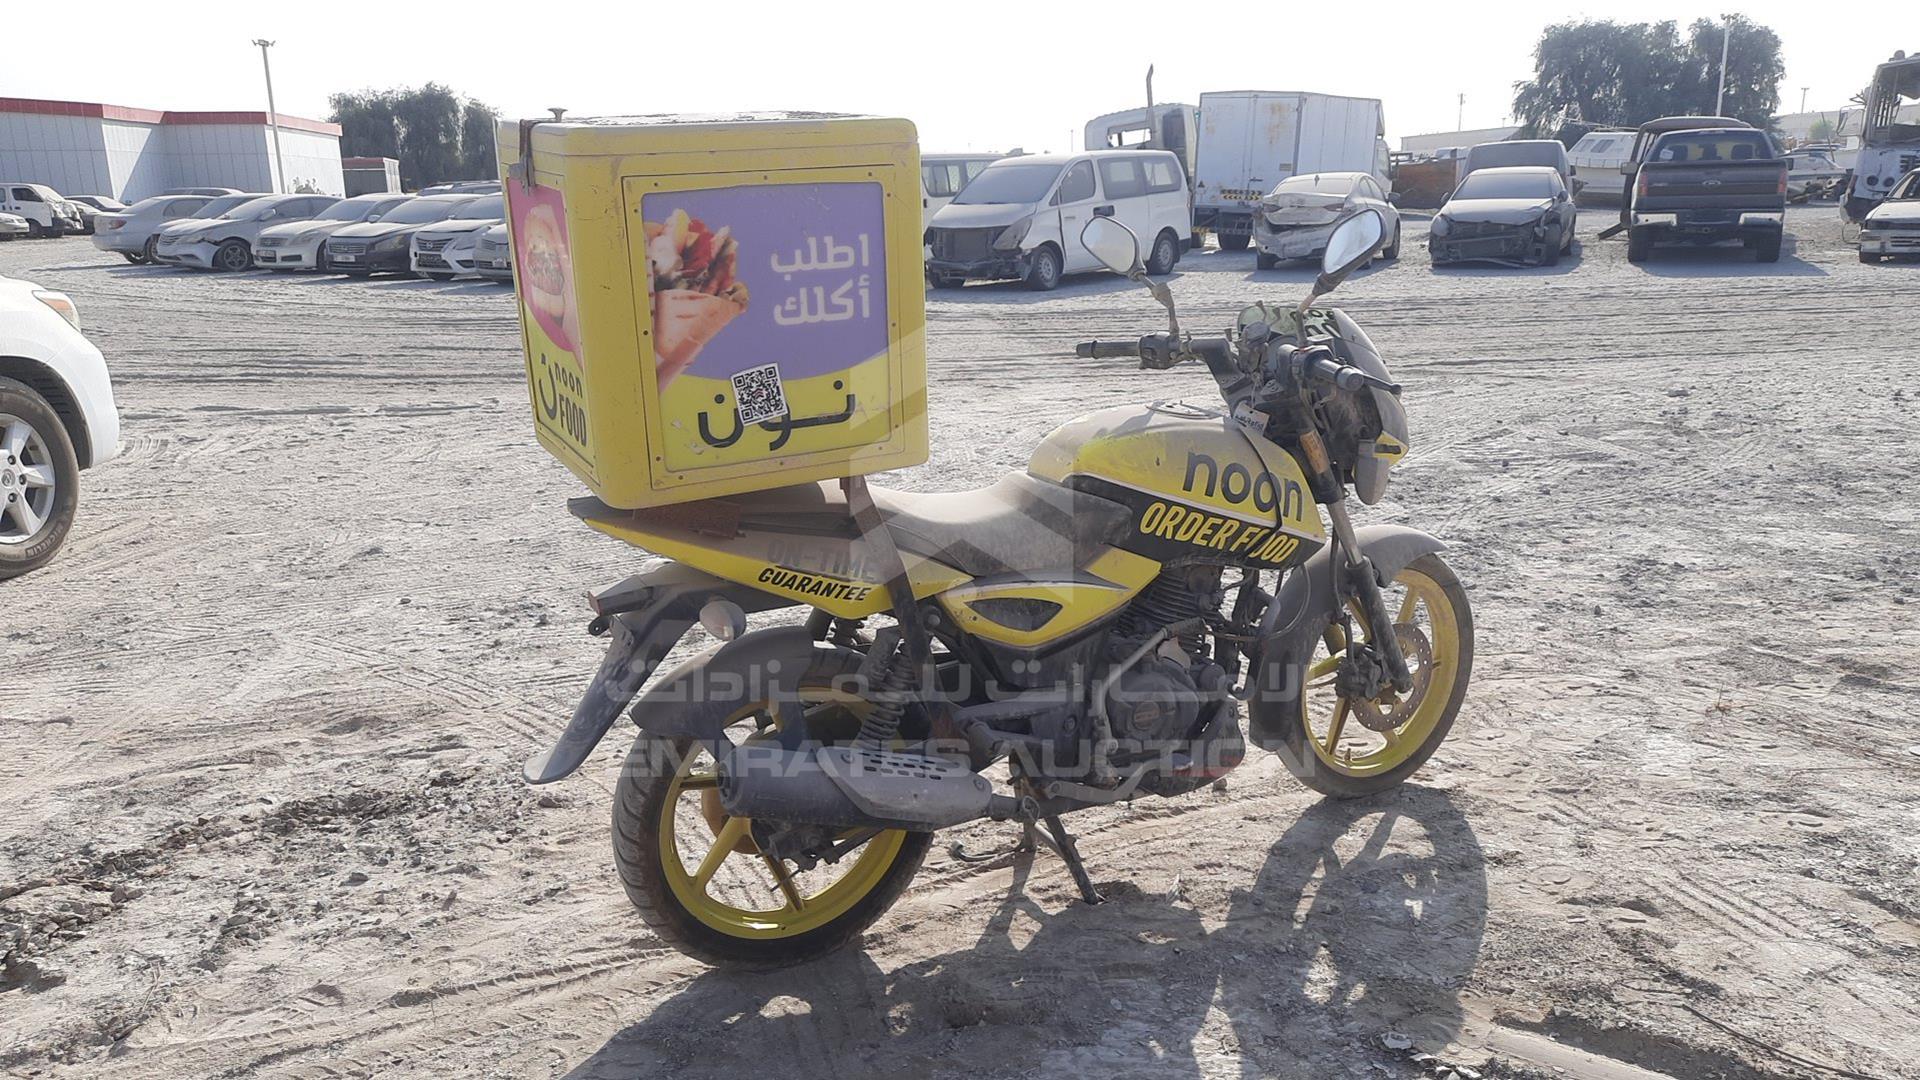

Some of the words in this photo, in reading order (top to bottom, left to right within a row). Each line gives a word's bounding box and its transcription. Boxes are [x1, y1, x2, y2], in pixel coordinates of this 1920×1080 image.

[770, 233, 870, 281] اطلب
[773, 274, 871, 326] أكلك
[554, 361, 583, 399] noon
[558, 393, 587, 447] FOOD
[1182, 451, 1304, 522] noon
[26, 521, 65, 558] MICHELIN
[1139, 502, 1241, 551] ORDER
[758, 567, 872, 601] GUARANTEE
